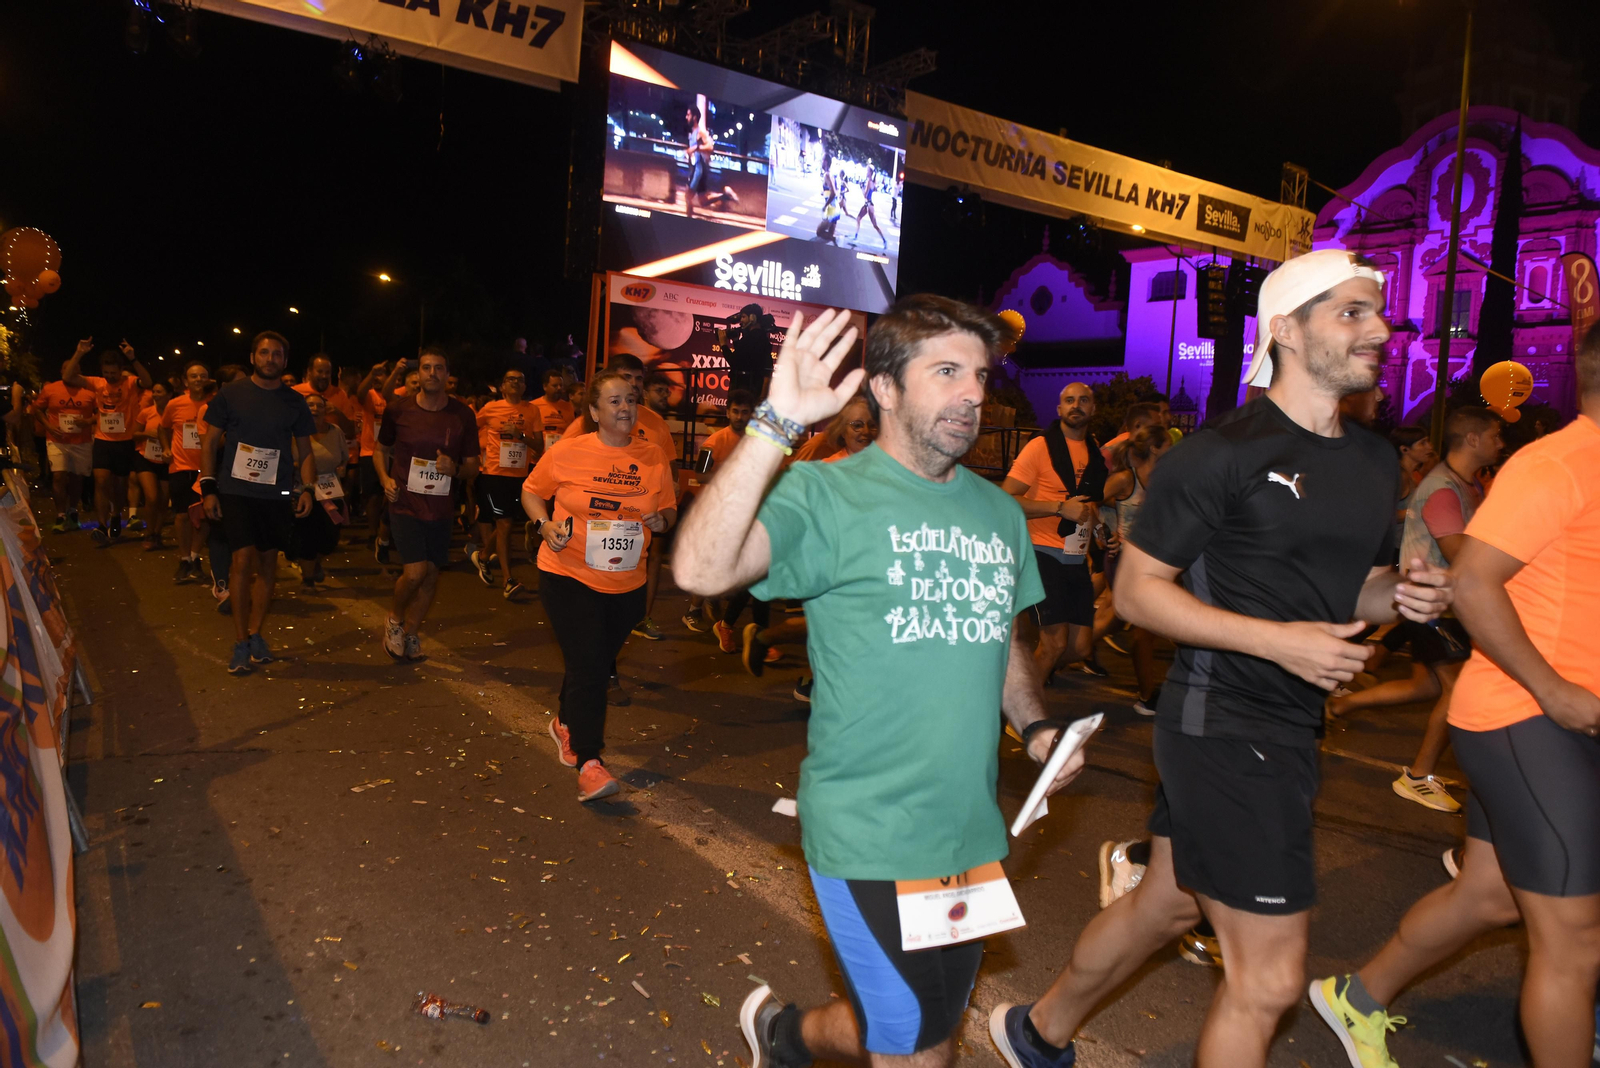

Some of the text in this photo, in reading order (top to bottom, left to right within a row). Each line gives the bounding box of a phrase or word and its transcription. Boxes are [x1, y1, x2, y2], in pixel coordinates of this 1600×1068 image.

[910, 118, 1047, 180] NOCTURNA
[1053, 161, 1140, 206] SEVILLA
[663, 291, 679, 301] ABC
[685, 296, 717, 308] Cruzcampo
[246, 457, 269, 470] 2795
[419, 470, 445, 482] 11637
[593, 476, 623, 485] SEVILLA
[608, 472, 642, 481] NOCTURNA
[601, 537, 634, 551] 13531
[888, 526, 960, 558] ESCUELA
[910, 577, 937, 601] DE
[890, 613, 946, 639] PARA
